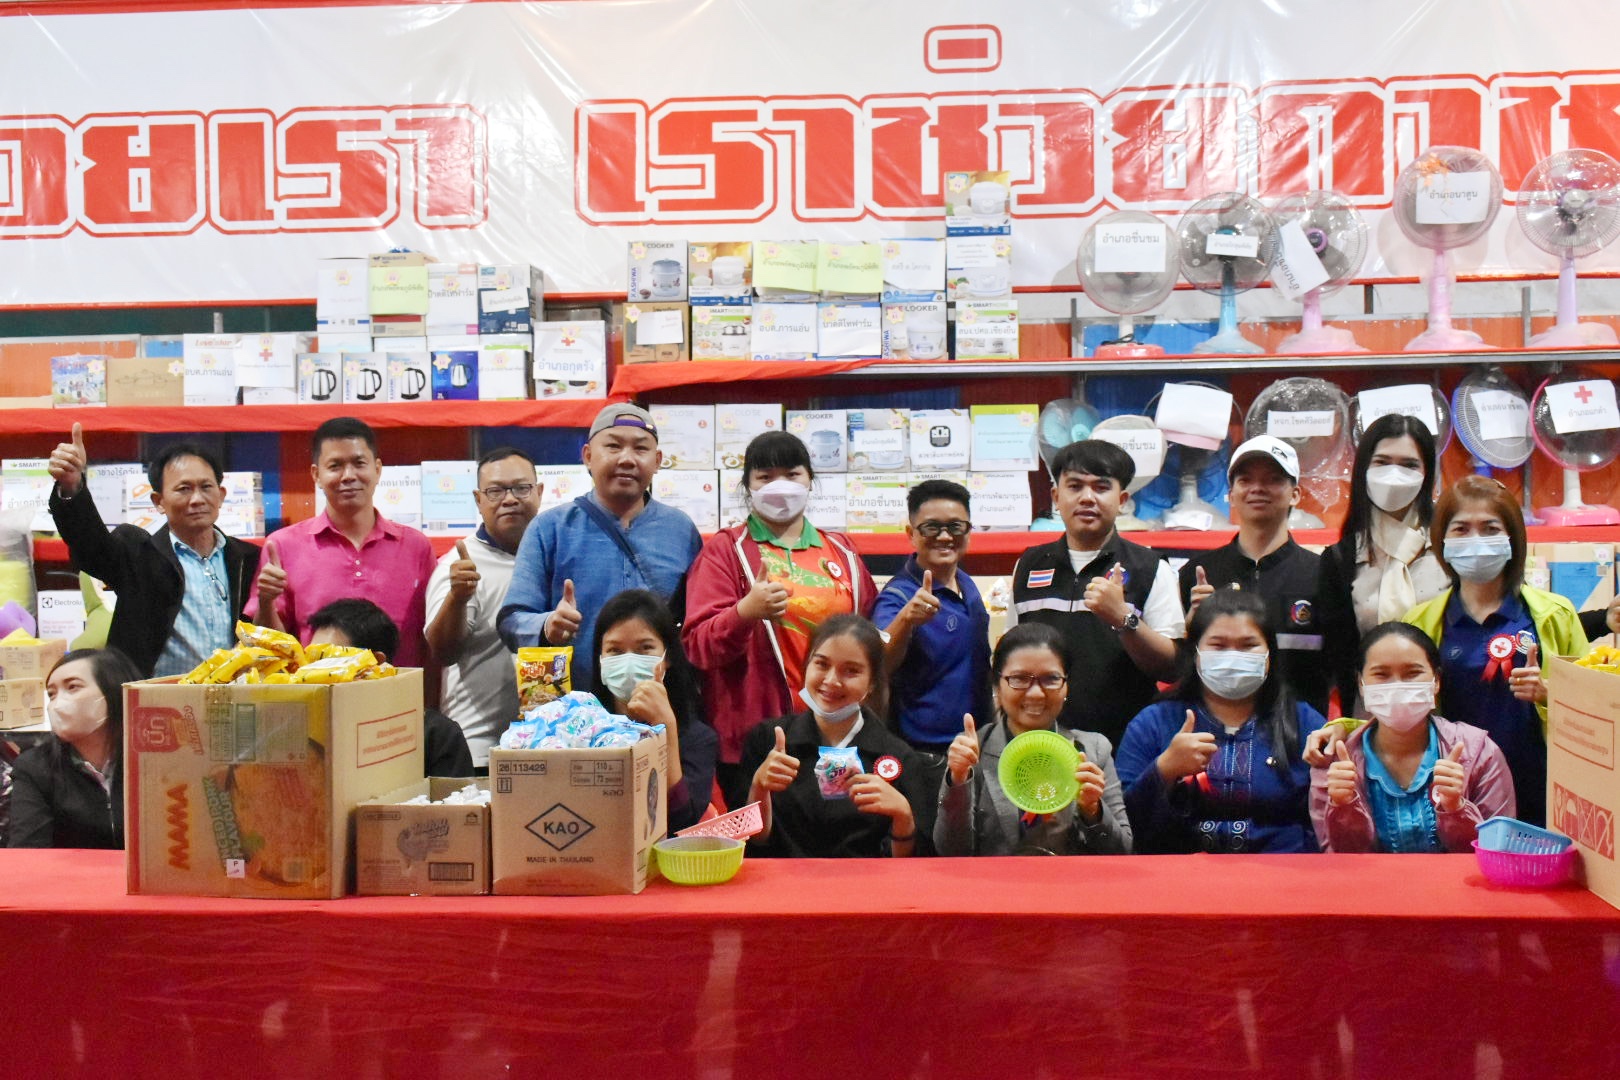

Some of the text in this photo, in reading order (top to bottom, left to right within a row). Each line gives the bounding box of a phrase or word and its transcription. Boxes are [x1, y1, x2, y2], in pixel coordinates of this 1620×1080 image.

[1102, 229, 1160, 244] อำเภอชื่นชม
[849, 491, 904, 507] อำเภอชื่นชม
[513, 763, 546, 772] 113429
[166, 783, 190, 871] MAMA
[544, 821, 580, 835] KAO
[526, 856, 595, 864] MADE IN THAILAND
